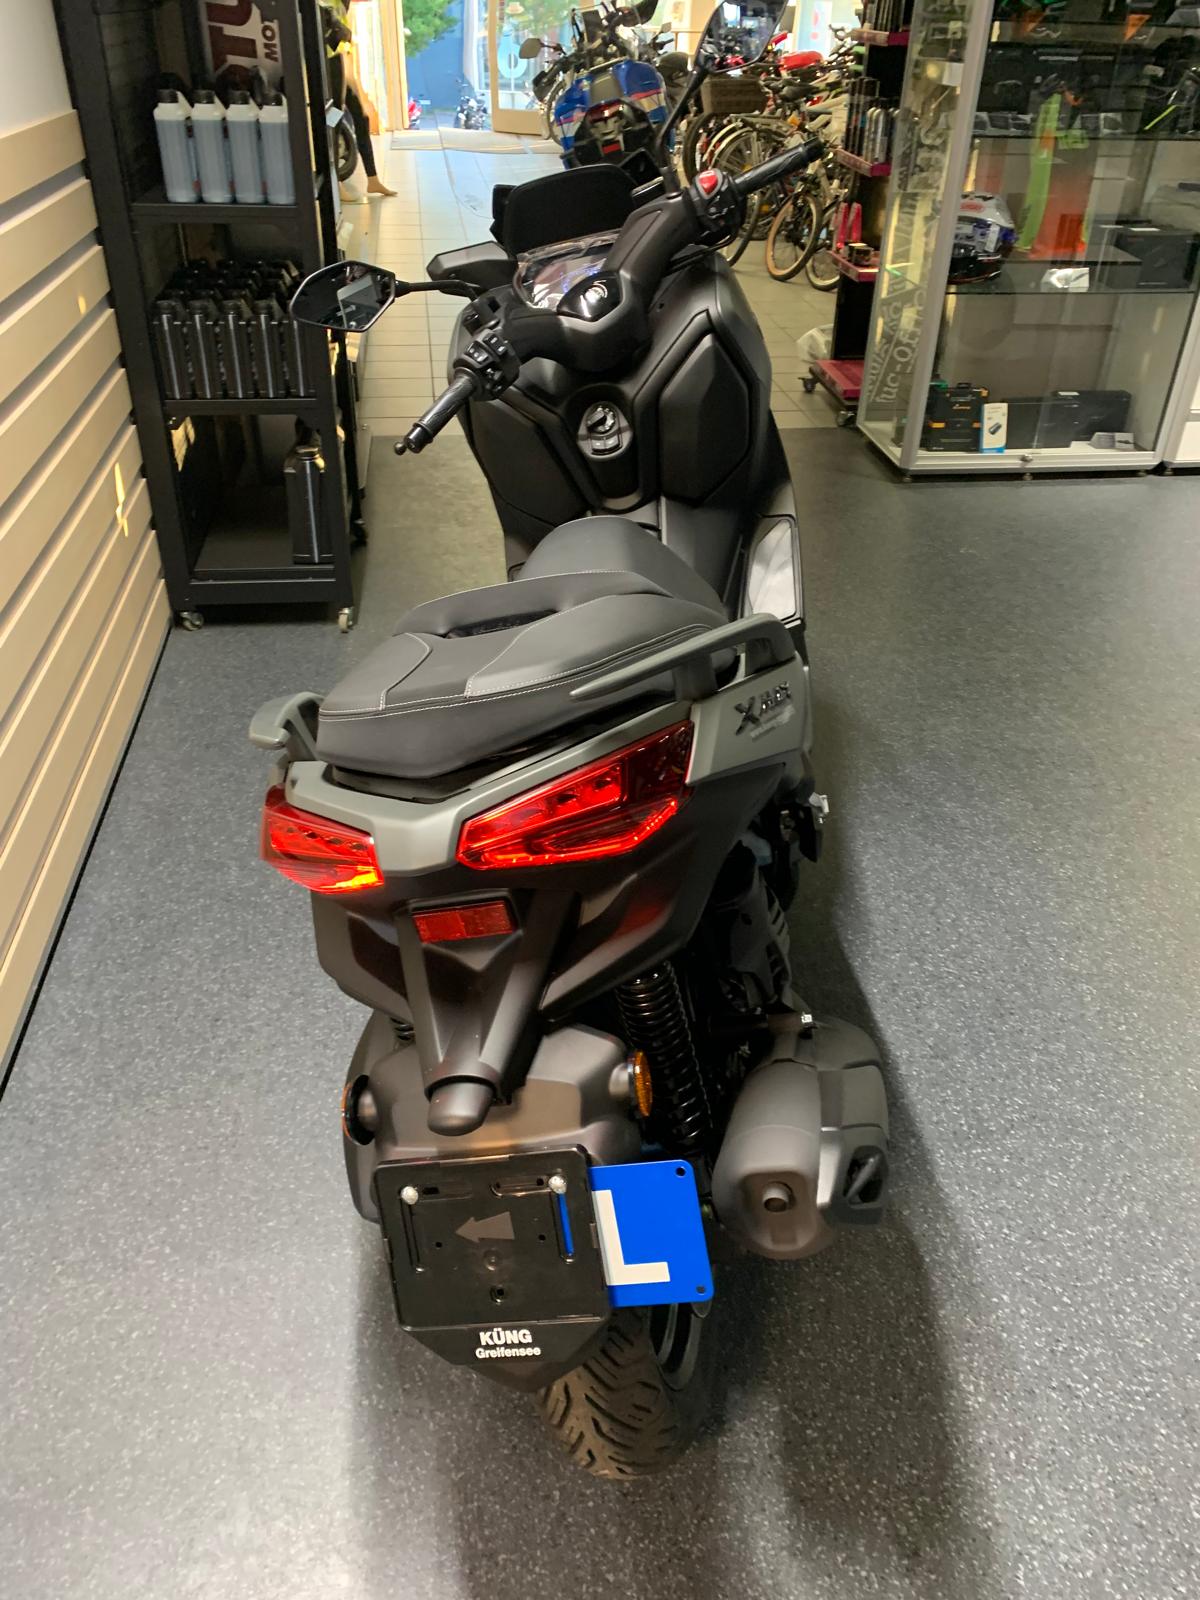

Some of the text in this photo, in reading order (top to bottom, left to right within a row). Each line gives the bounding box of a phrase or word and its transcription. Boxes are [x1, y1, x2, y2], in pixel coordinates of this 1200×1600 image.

[591, 1189, 671, 1286] L
[479, 1327, 533, 1346] KÜNG
[475, 1346, 542, 1359] Greifensee
